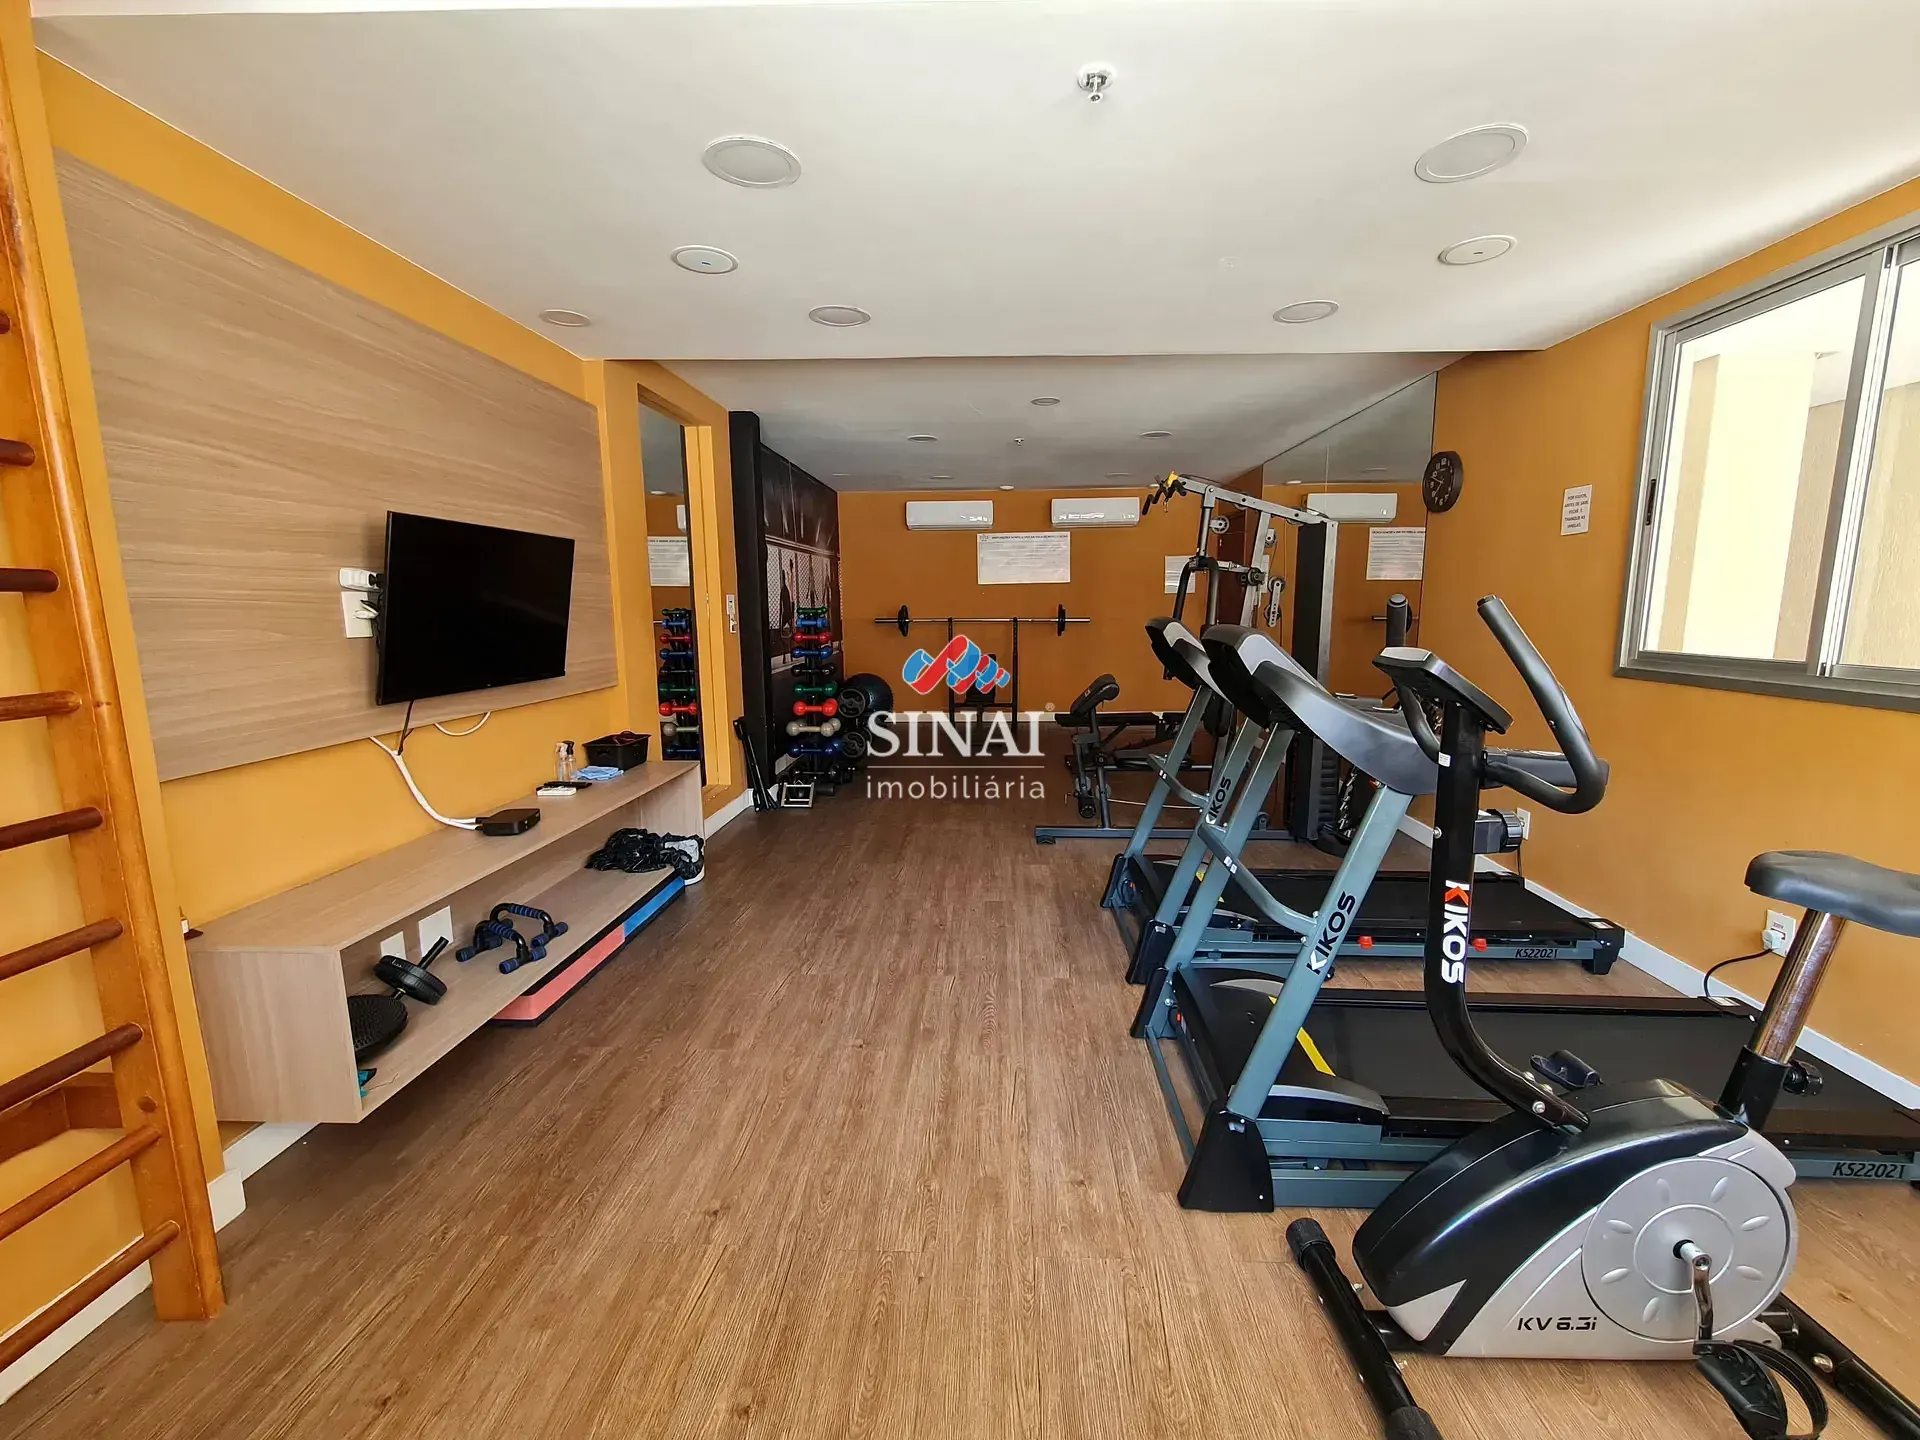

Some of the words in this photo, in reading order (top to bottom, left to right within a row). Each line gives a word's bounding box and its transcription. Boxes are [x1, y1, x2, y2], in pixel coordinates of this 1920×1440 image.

[1306, 891, 1356, 975] KIKOS
[1441, 879, 1470, 984] KIKOS
[1832, 1161, 1907, 1179] KS22021
[1517, 1316, 1553, 1331] KV
